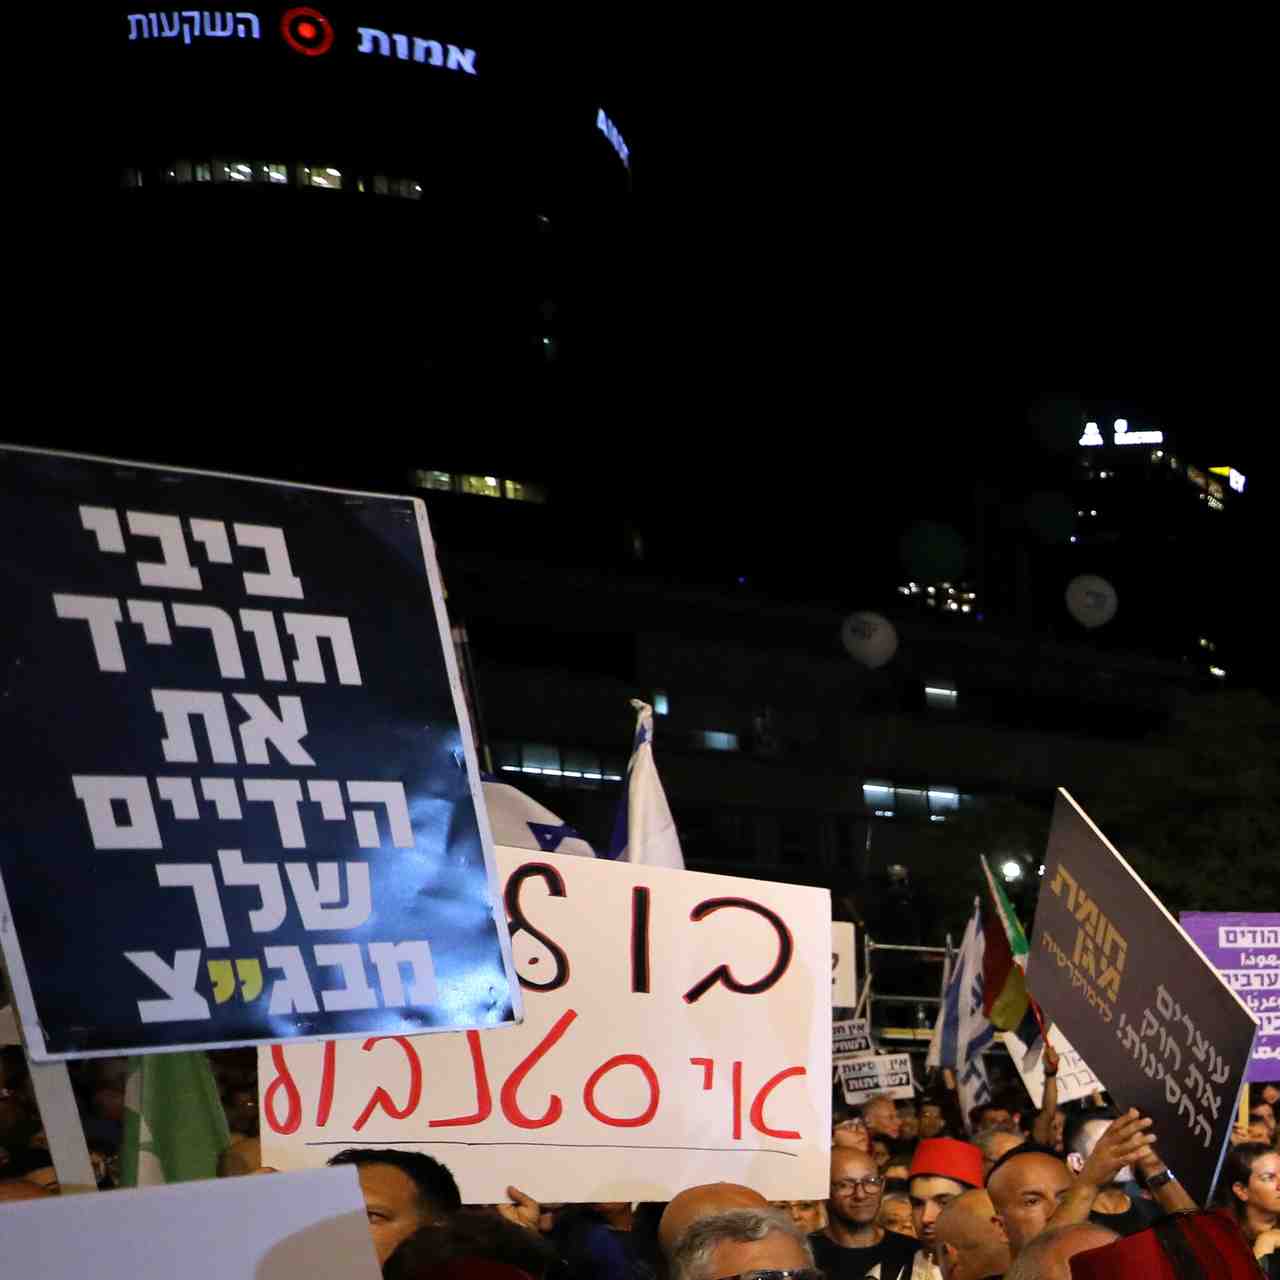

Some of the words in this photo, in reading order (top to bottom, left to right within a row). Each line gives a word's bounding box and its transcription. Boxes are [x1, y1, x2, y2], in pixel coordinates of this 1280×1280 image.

[127, 10, 260, 45] השקעות
[357, 25, 477, 75] אמות
[79, 504, 304, 599] ביבי
[53, 592, 363, 686] תוריד
[151, 688, 316, 767] את
[72, 774, 415, 849] הידיים
[156, 850, 372, 947] שלך
[1051, 864, 1127, 971] חומת
[1140, 1008, 1181, 1070] חוק
[1156, 984, 1230, 1084] עוצרים
[1185, 1063, 1221, 1120] את
